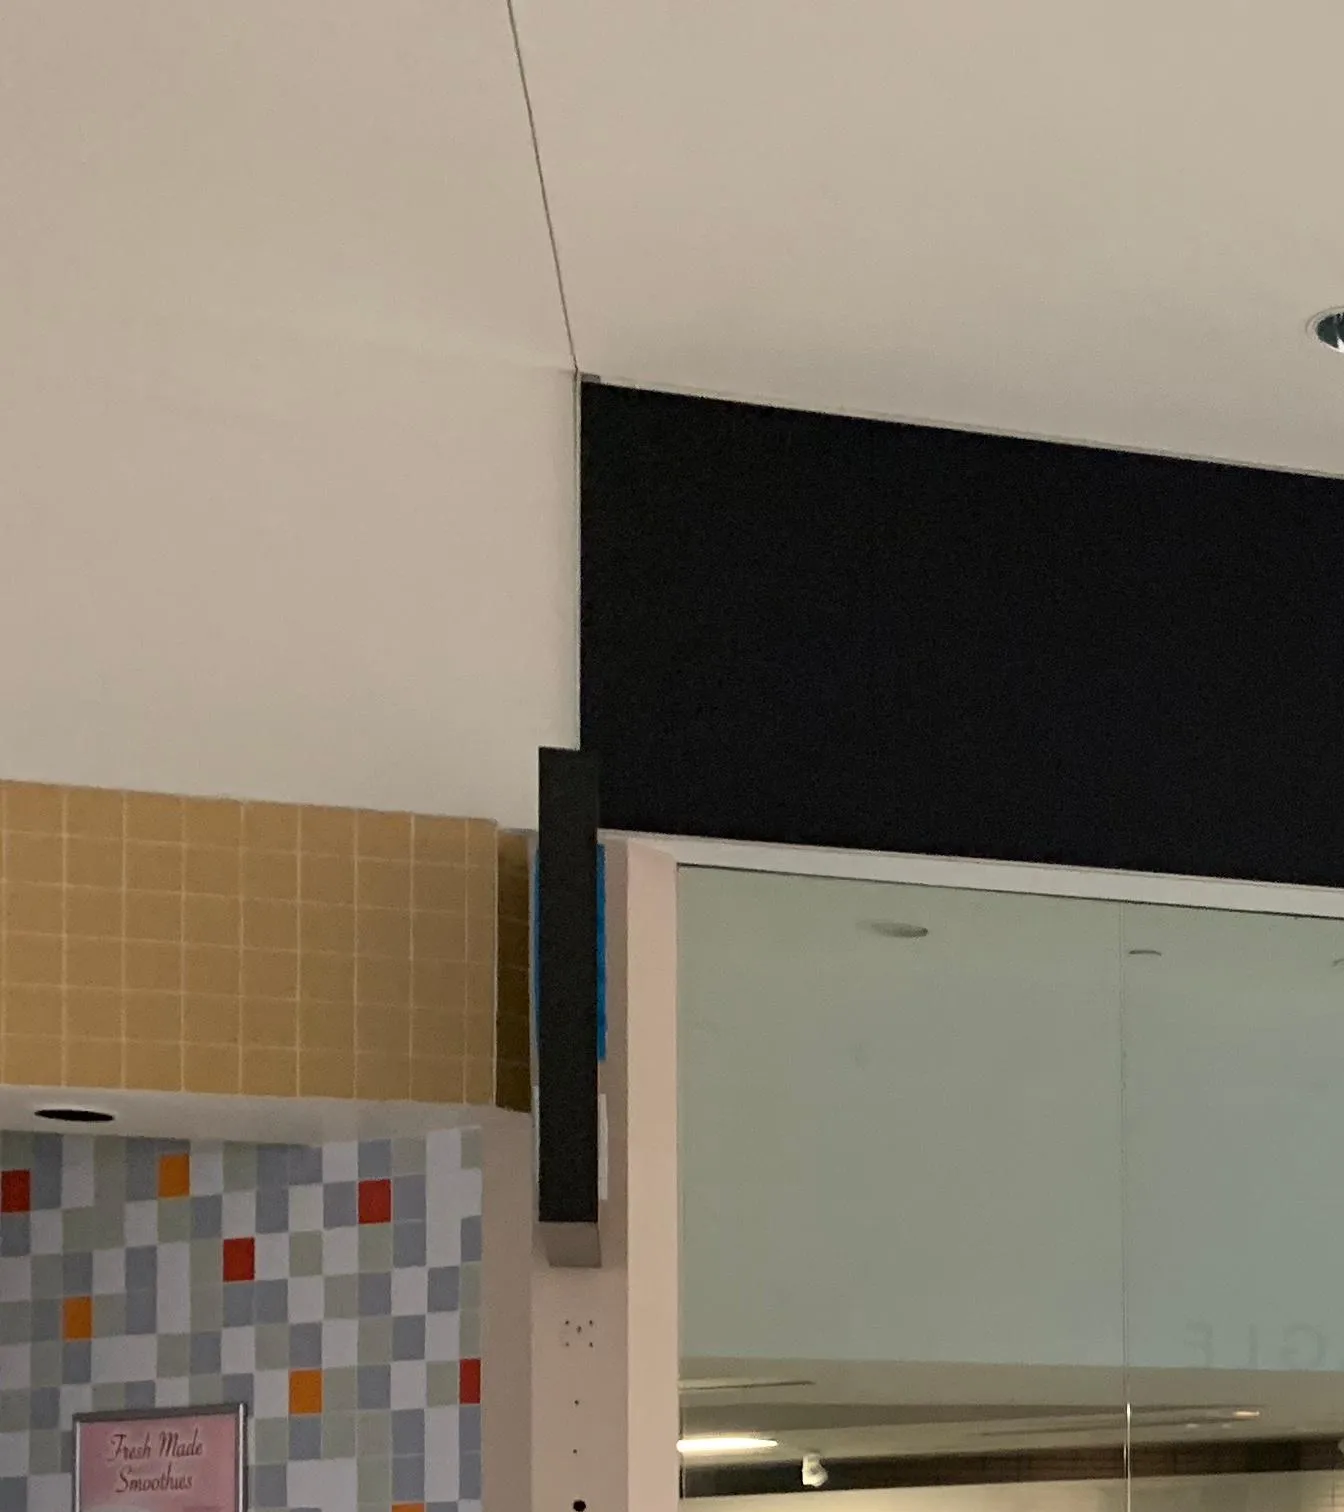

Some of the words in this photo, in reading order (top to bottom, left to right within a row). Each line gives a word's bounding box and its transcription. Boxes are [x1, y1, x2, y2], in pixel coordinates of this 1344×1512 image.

[108, 1432, 152, 1461] Fresh
[159, 1427, 204, 1458] Made
[115, 1461, 193, 1493] Smoothies
